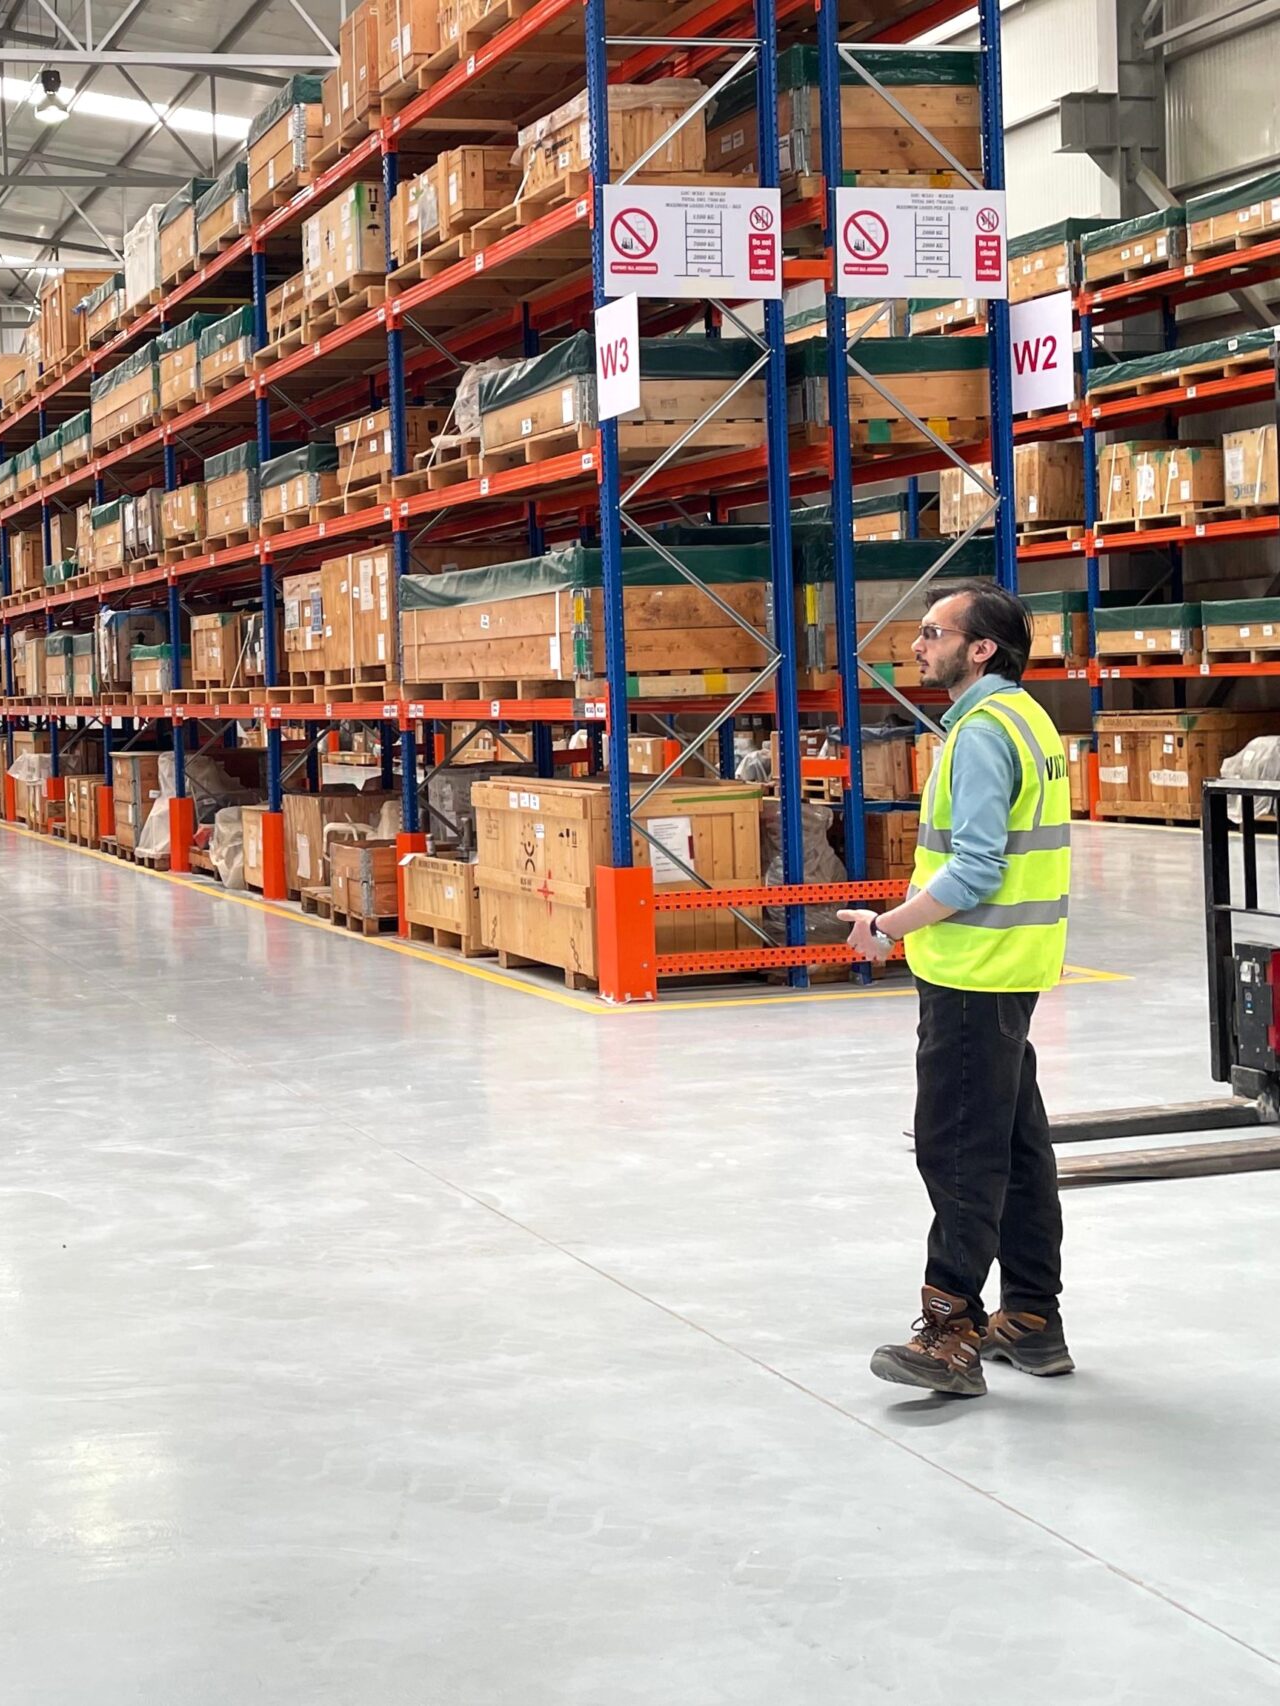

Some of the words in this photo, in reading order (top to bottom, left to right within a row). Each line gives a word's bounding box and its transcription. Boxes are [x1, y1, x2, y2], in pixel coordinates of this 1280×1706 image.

[751, 267, 774, 276] racking
[977, 268, 999, 277] racking
[600, 337, 629, 380] W3
[1012, 335, 1058, 375] W2
